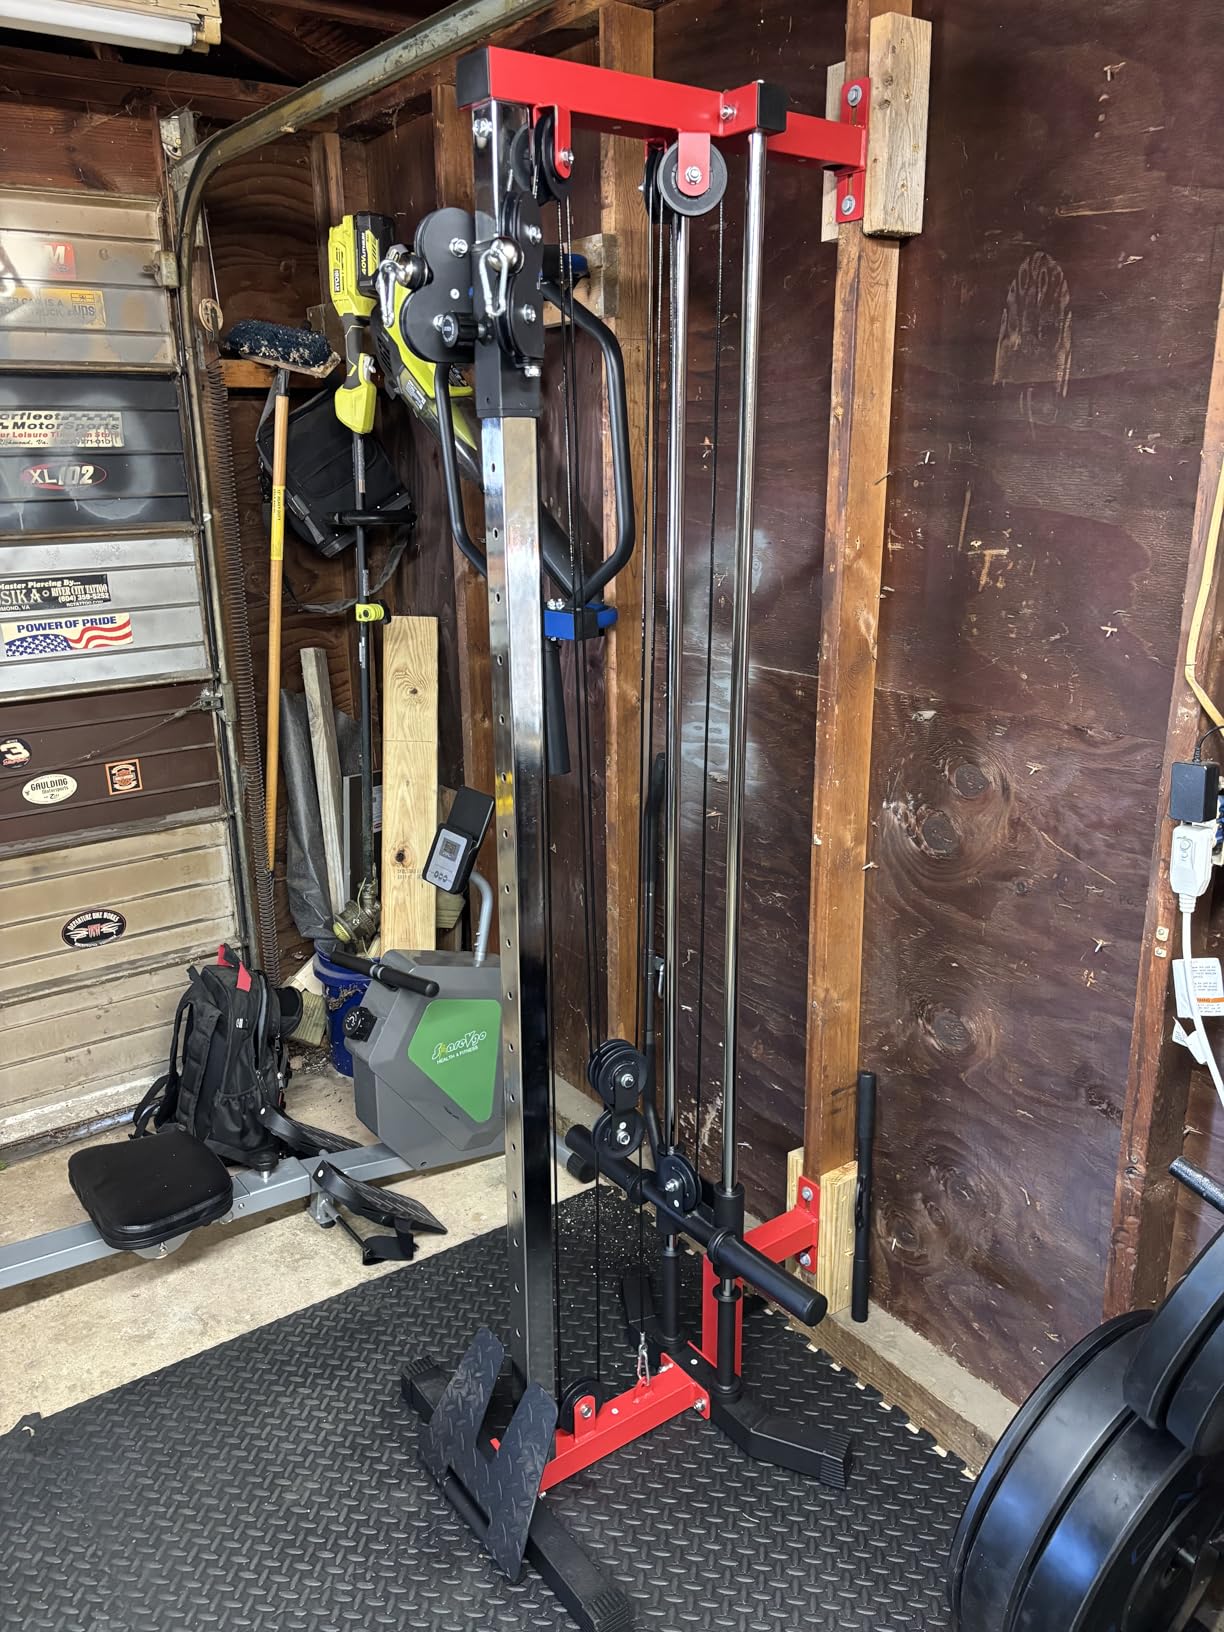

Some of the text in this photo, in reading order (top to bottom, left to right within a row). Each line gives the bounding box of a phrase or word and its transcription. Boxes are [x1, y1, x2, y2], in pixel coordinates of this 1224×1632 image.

[12, 422, 120, 431] MotorSports
[28, 580, 61, 589] Piercing
[17, 616, 116, 633] POWER OF PRIDE
[0, 742, 30, 760] 3
[30, 778, 68, 791] GAULDING
